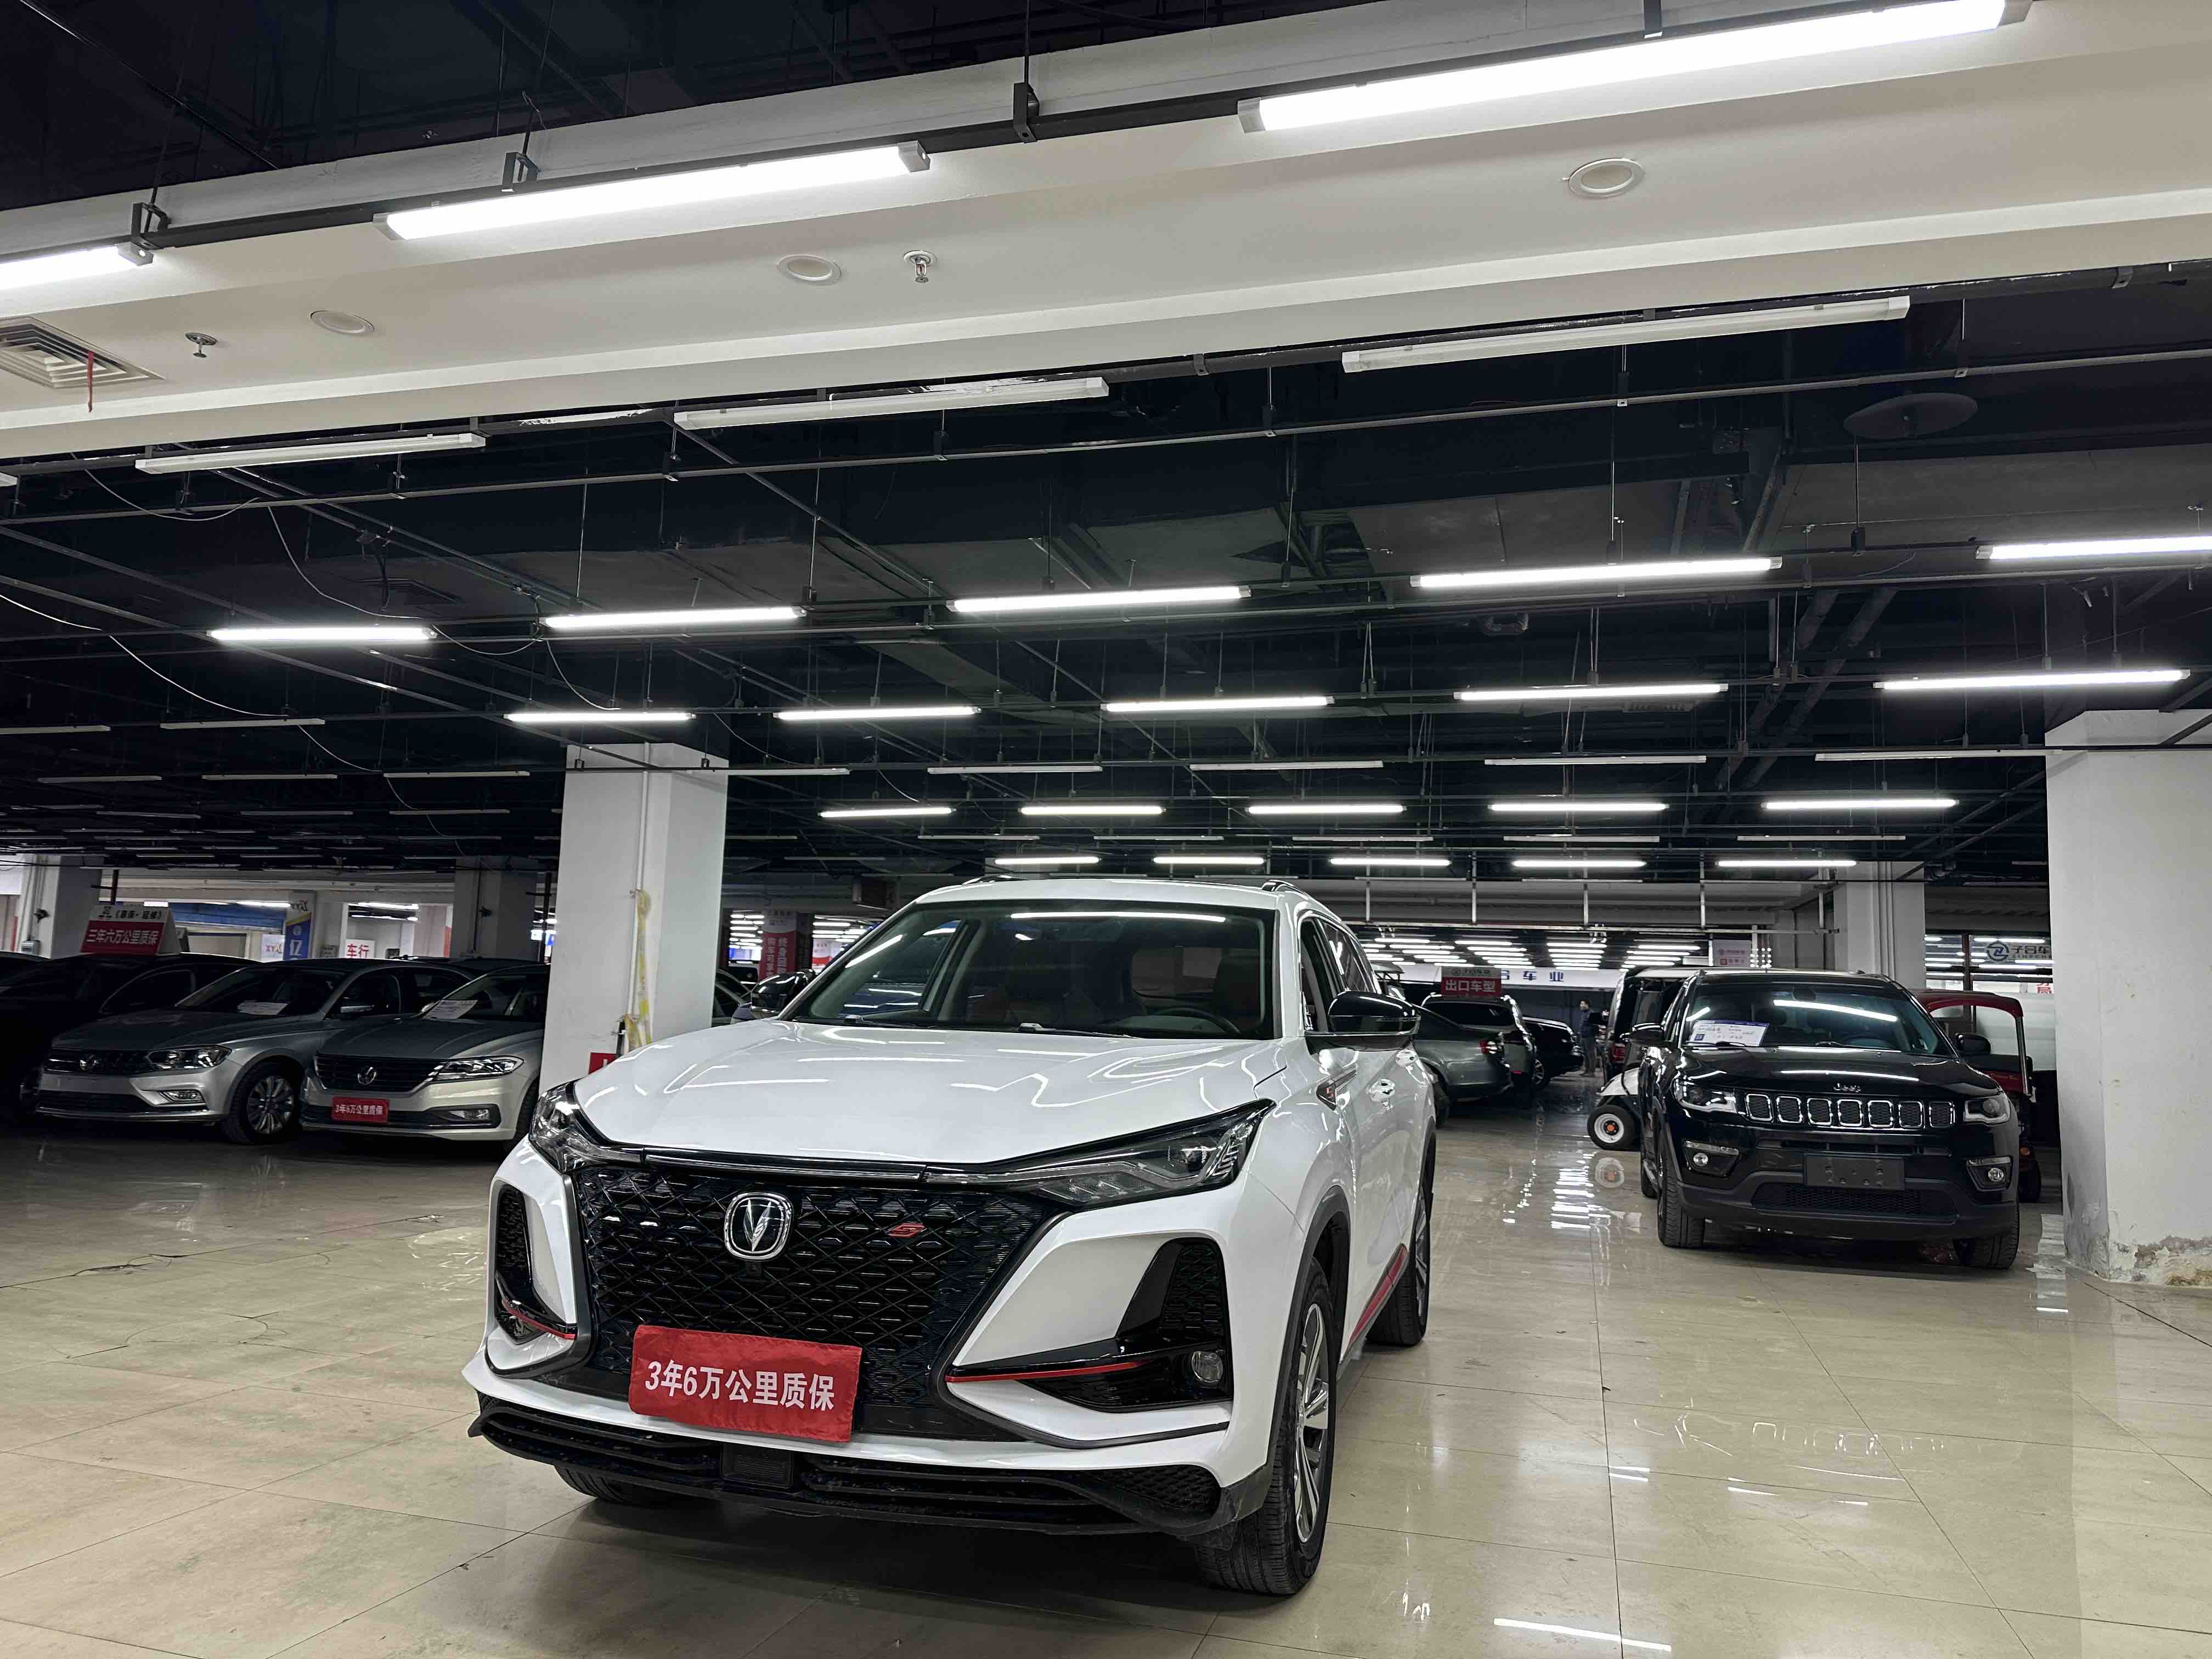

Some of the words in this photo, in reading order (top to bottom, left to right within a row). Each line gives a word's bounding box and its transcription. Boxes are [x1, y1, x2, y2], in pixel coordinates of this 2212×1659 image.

[86, 929, 159, 945] 三年六万公里质保
[346, 943, 369, 958] 车行
[1445, 980, 1496, 992] 出口车型
[1833, 1082, 1861, 1093] Jeep
[645, 1359, 835, 1412] 3年6万公里质保
